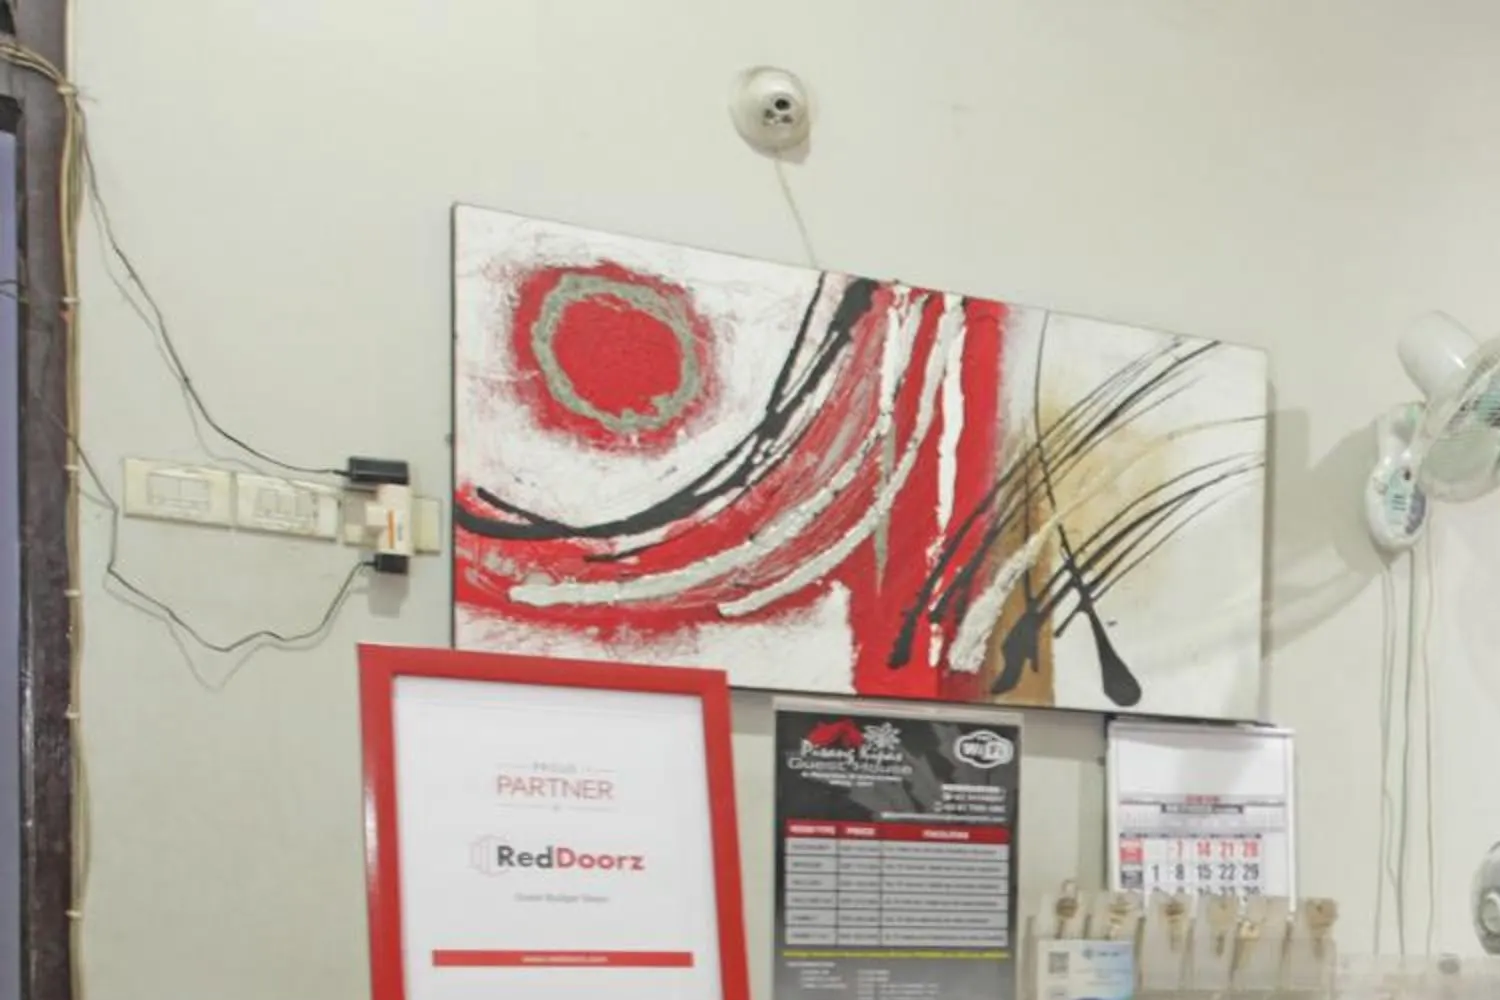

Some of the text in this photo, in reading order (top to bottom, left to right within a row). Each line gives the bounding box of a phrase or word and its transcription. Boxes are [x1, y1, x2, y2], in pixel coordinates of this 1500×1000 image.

[496, 775, 615, 800] PARTNER
[496, 845, 646, 871] RedDoorz
[1197, 864, 1212, 881] 15
[1219, 864, 1235, 881] 22
[1242, 864, 1259, 881] 29
